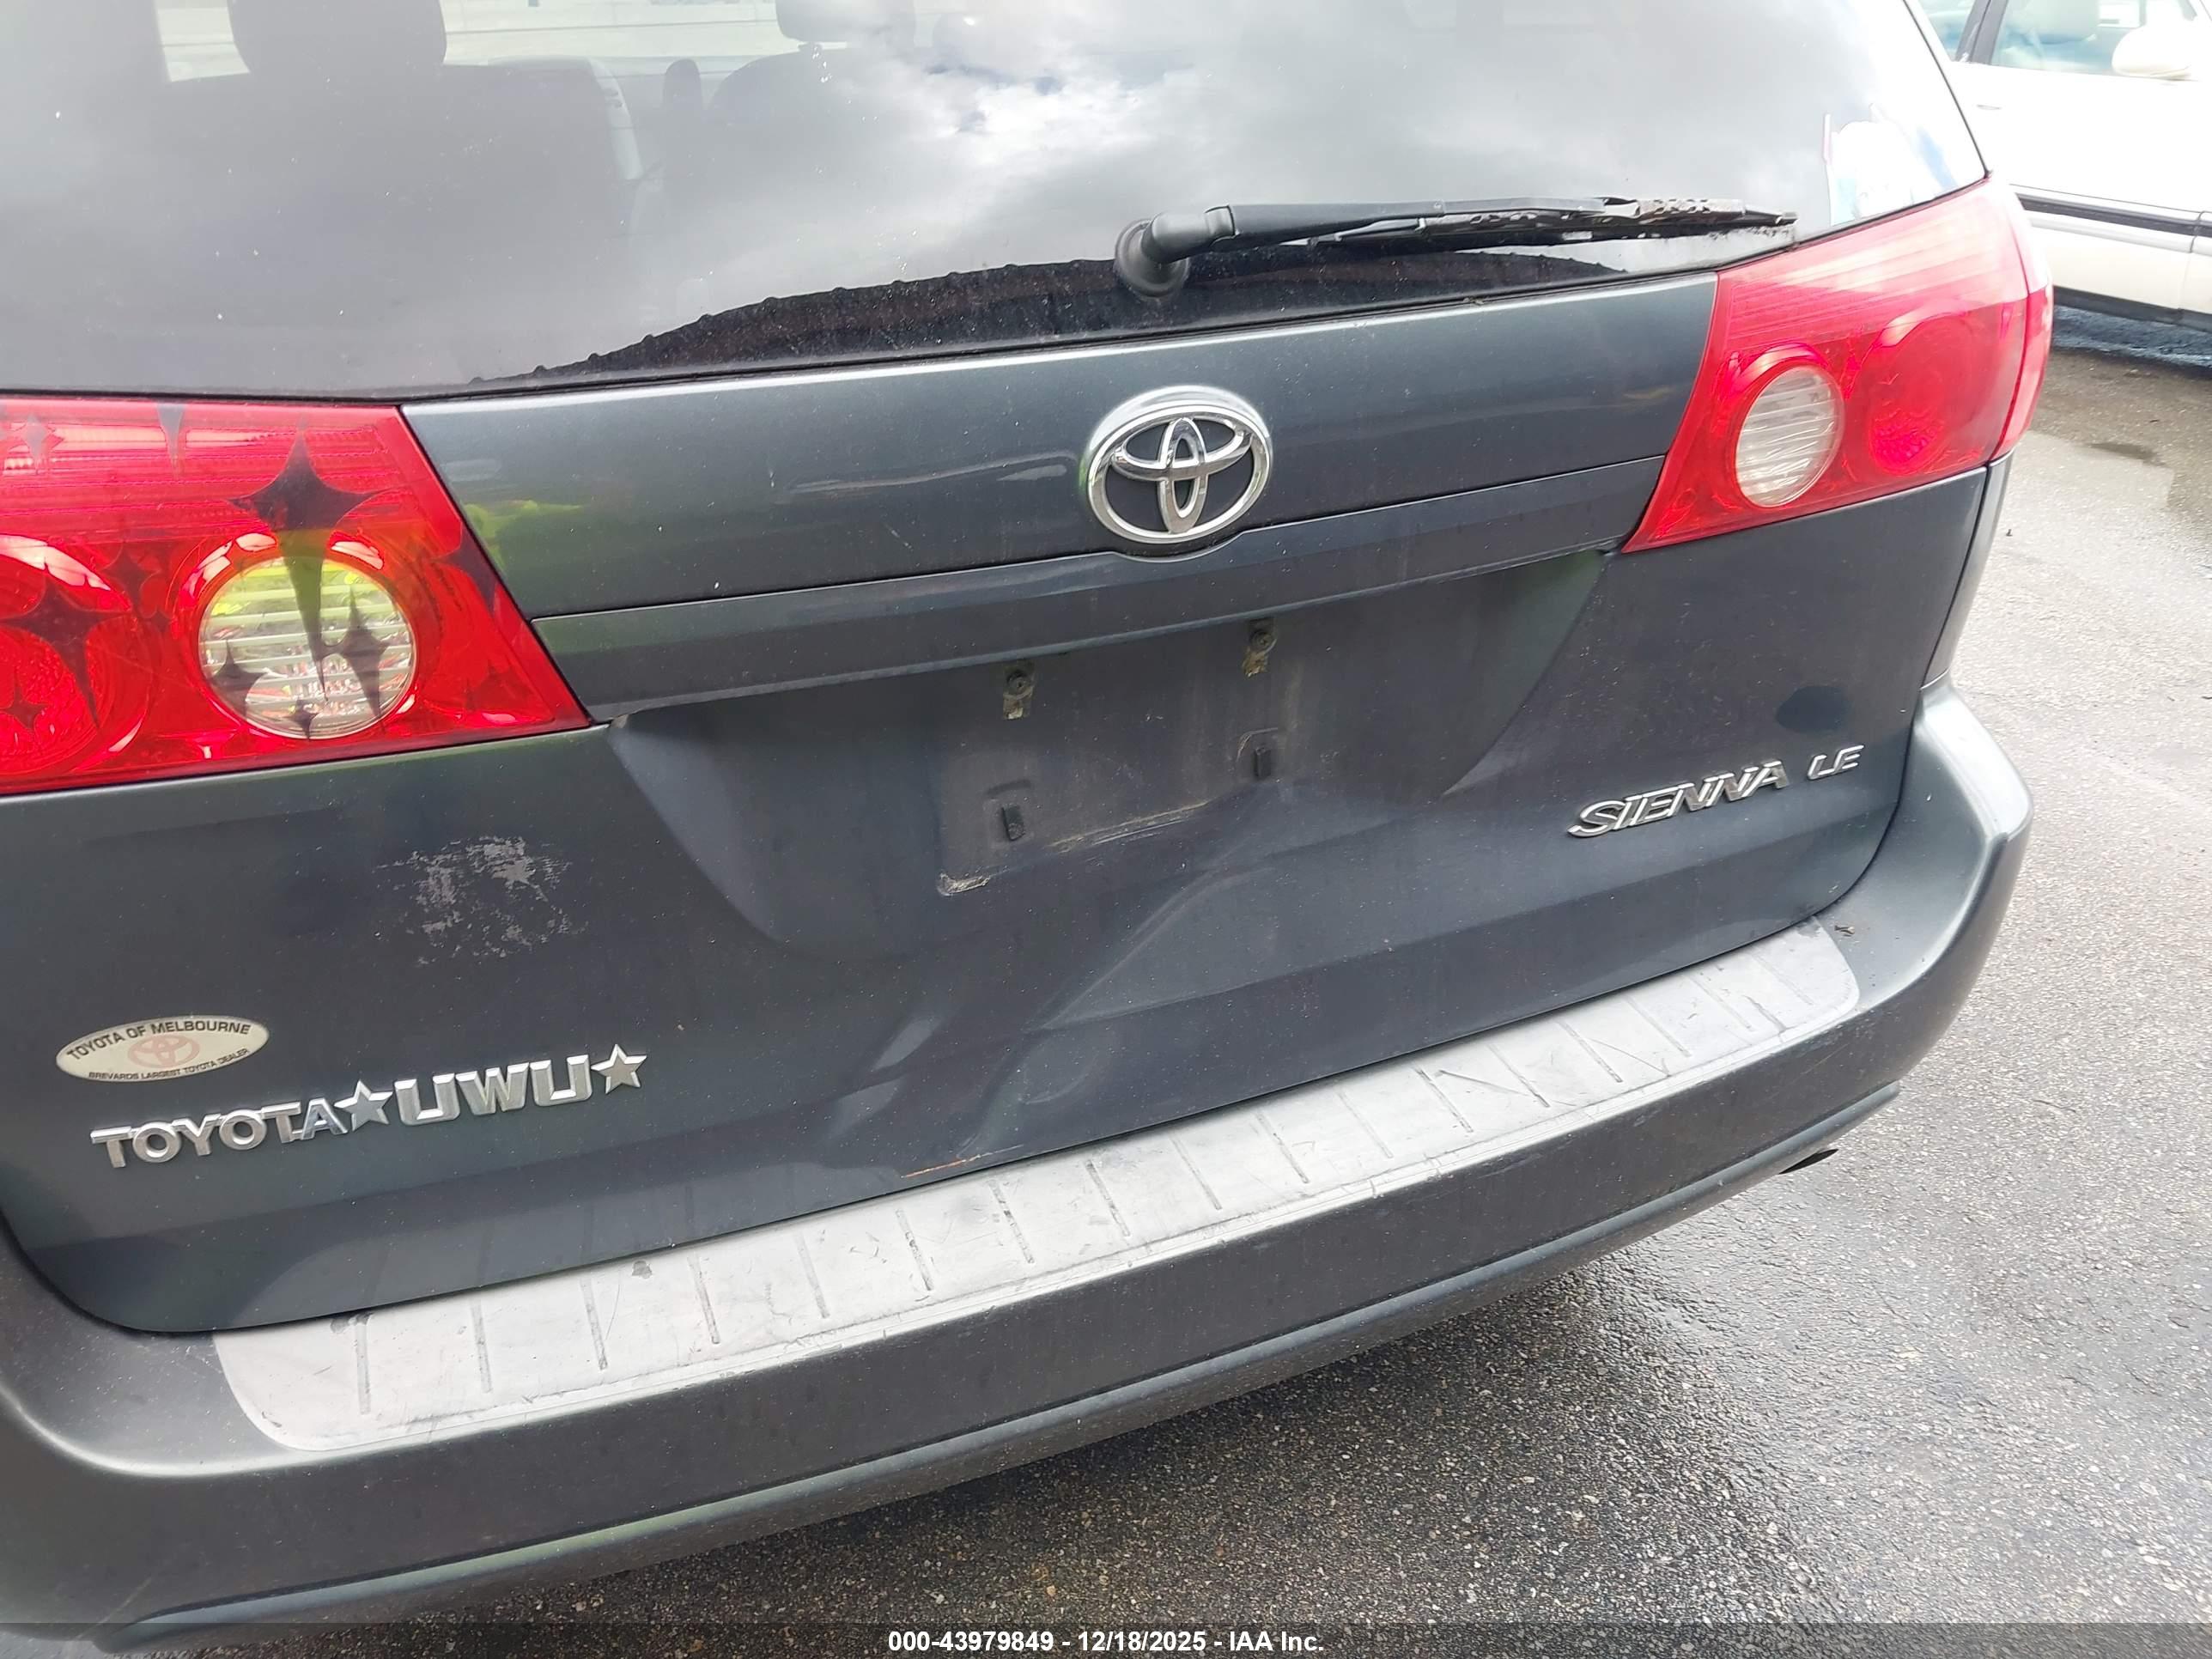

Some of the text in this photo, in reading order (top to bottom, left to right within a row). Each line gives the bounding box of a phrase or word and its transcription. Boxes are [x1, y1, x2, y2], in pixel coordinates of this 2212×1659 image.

[1567, 744, 1865, 838] SIENNA LE
[68, 1019, 252, 1060] TOYOTA OF MELBOURNE
[88, 1048, 250, 1080] BREVARDS LARGEST TOYOTA DEALER
[90, 1054, 592, 1169] TOYOTA UWU
